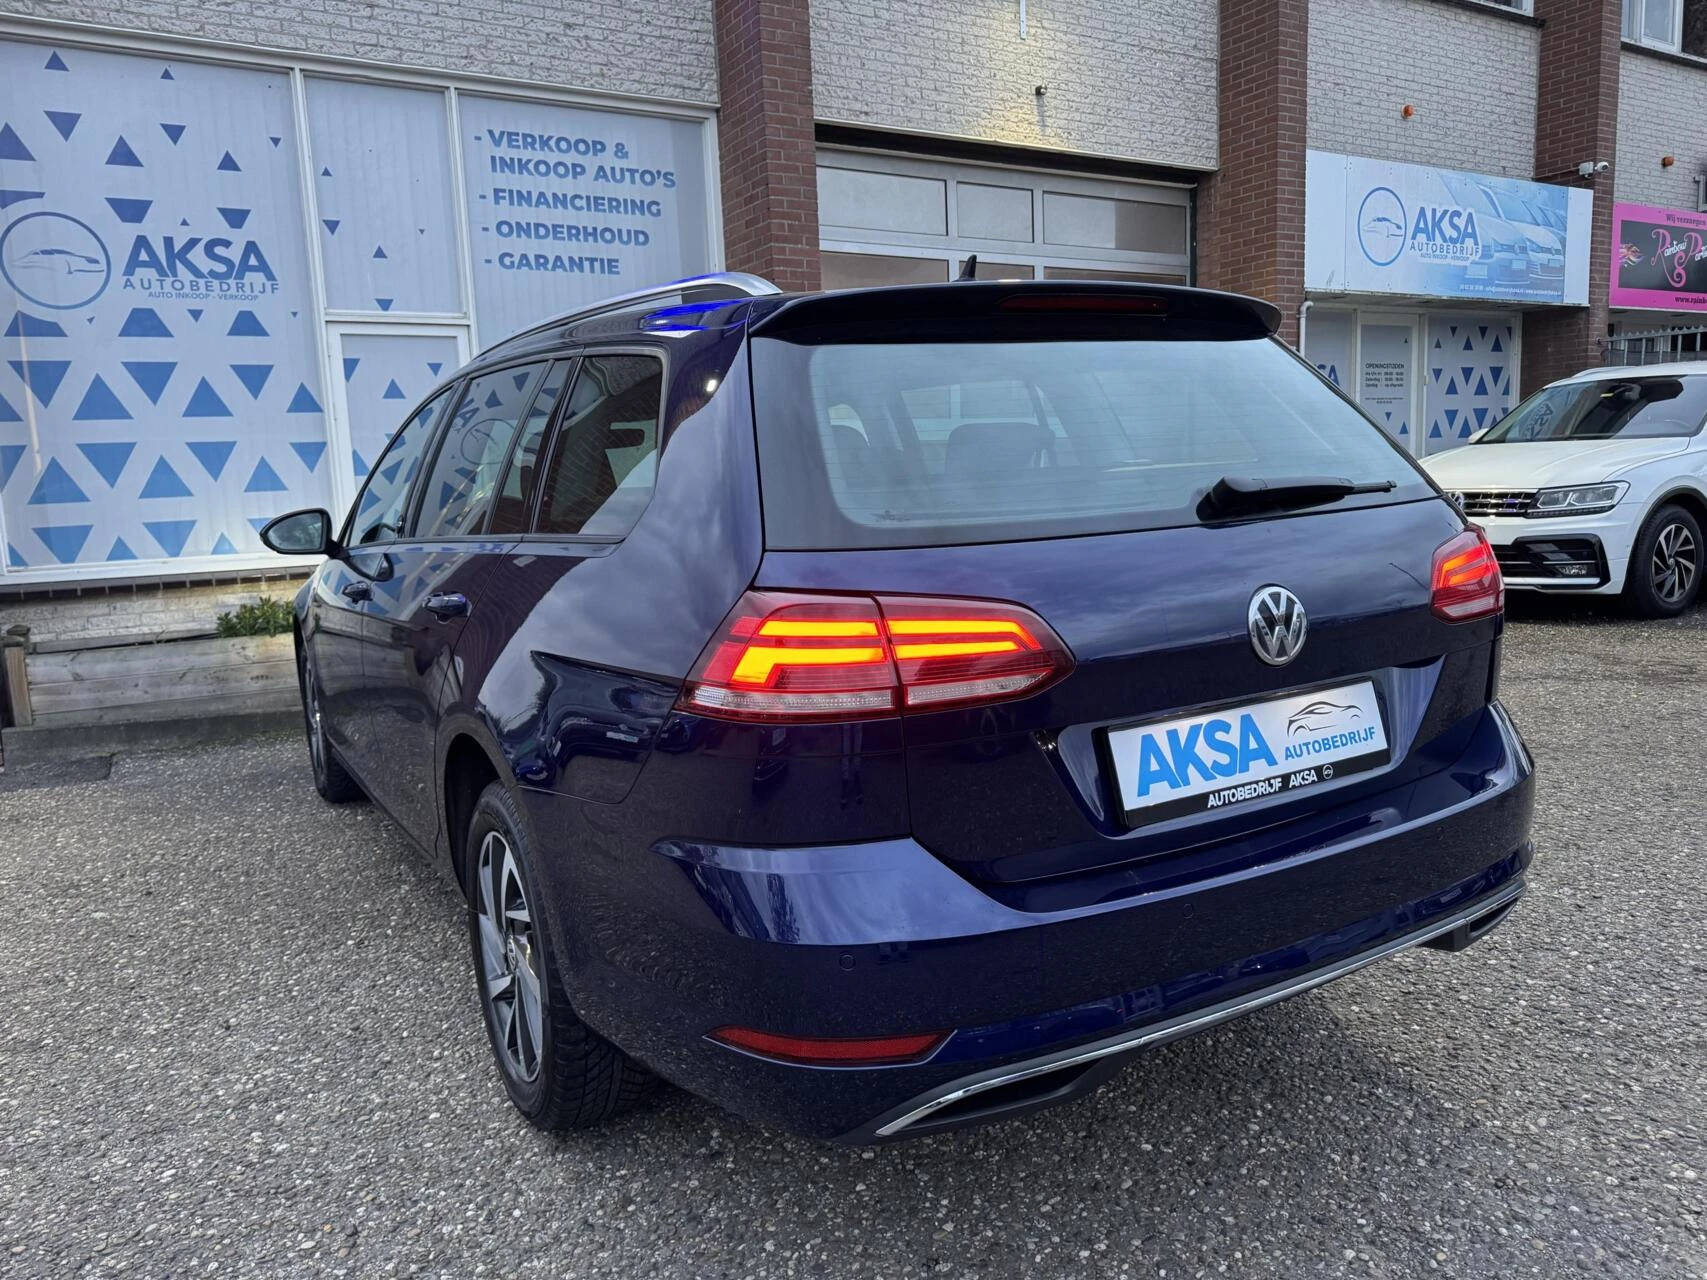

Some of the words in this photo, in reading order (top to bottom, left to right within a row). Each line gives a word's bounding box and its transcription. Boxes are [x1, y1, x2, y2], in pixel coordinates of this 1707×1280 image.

[487, 129, 607, 157] VERKOOP
[614, 142, 629, 160] &
[490, 155, 586, 180] INKOOP
[593, 165, 676, 188] AUTO'S
[493, 188, 662, 217] FINANCIERING
[495, 220, 650, 246] ONDERHOUD
[1410, 206, 1479, 246] AKSA
[122, 235, 278, 282] AKSA
[498, 252, 621, 276] GARANTIE
[1410, 240, 1480, 257] AUTOBEDRIJF
[123, 277, 280, 295] AUTOBEDRIJF
[175, 292, 210, 300] INKOOP
[217, 293, 259, 302] VERKOOP
[1137, 713, 1278, 798] AKSA
[1284, 726, 1376, 761] AUTOBEDRIJF
[1207, 777, 1282, 808] AUTOBEDRIJF
[1289, 769, 1318, 788] AKSA
